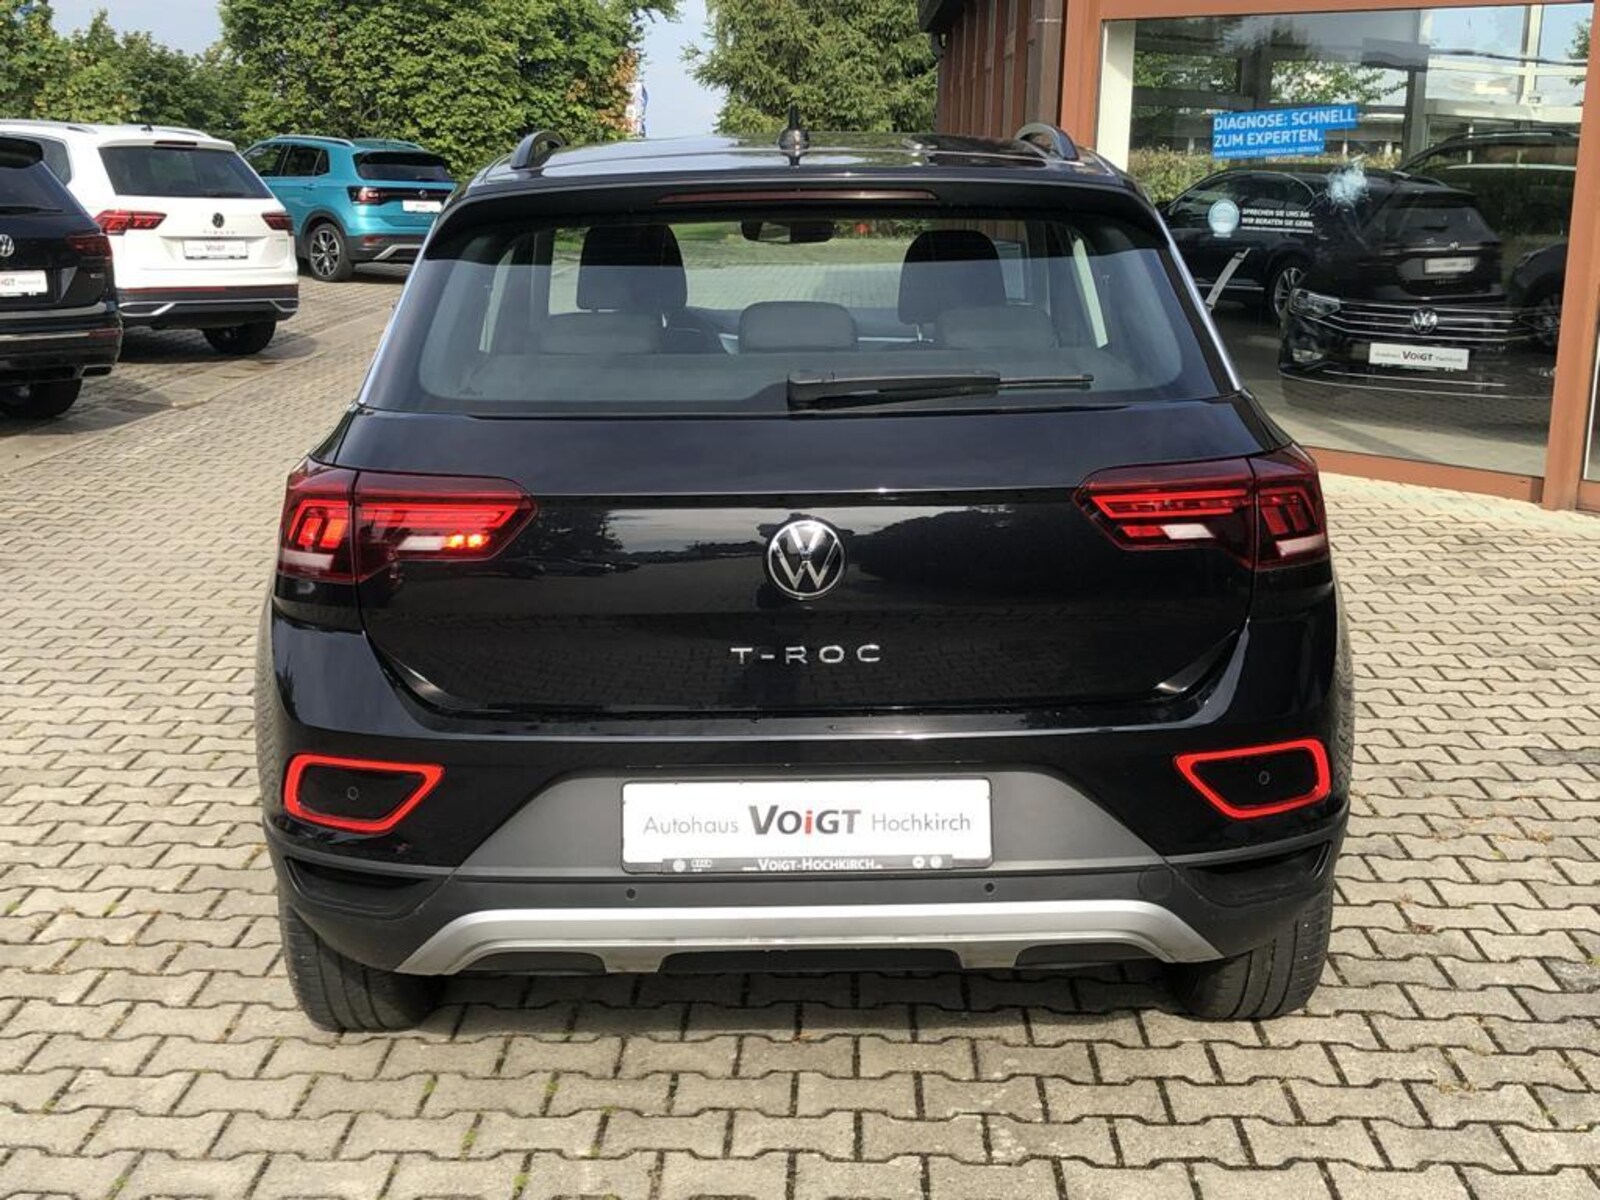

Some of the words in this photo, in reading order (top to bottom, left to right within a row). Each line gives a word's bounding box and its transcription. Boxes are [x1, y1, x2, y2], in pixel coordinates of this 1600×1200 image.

[1213, 113, 1288, 130] DIAGNOSE:
[1291, 108, 1356, 126] SCHNELL
[1214, 133, 1244, 148] ZUM
[1247, 129, 1322, 145] EXPERTEN.
[1242, 208, 1274, 217] SPRECHEN
[1255, 218, 1283, 226] BERATEN
[730, 644, 881, 664] T-ROC
[643, 815, 739, 834] Autohaus
[872, 812, 971, 831] Hochkirch
